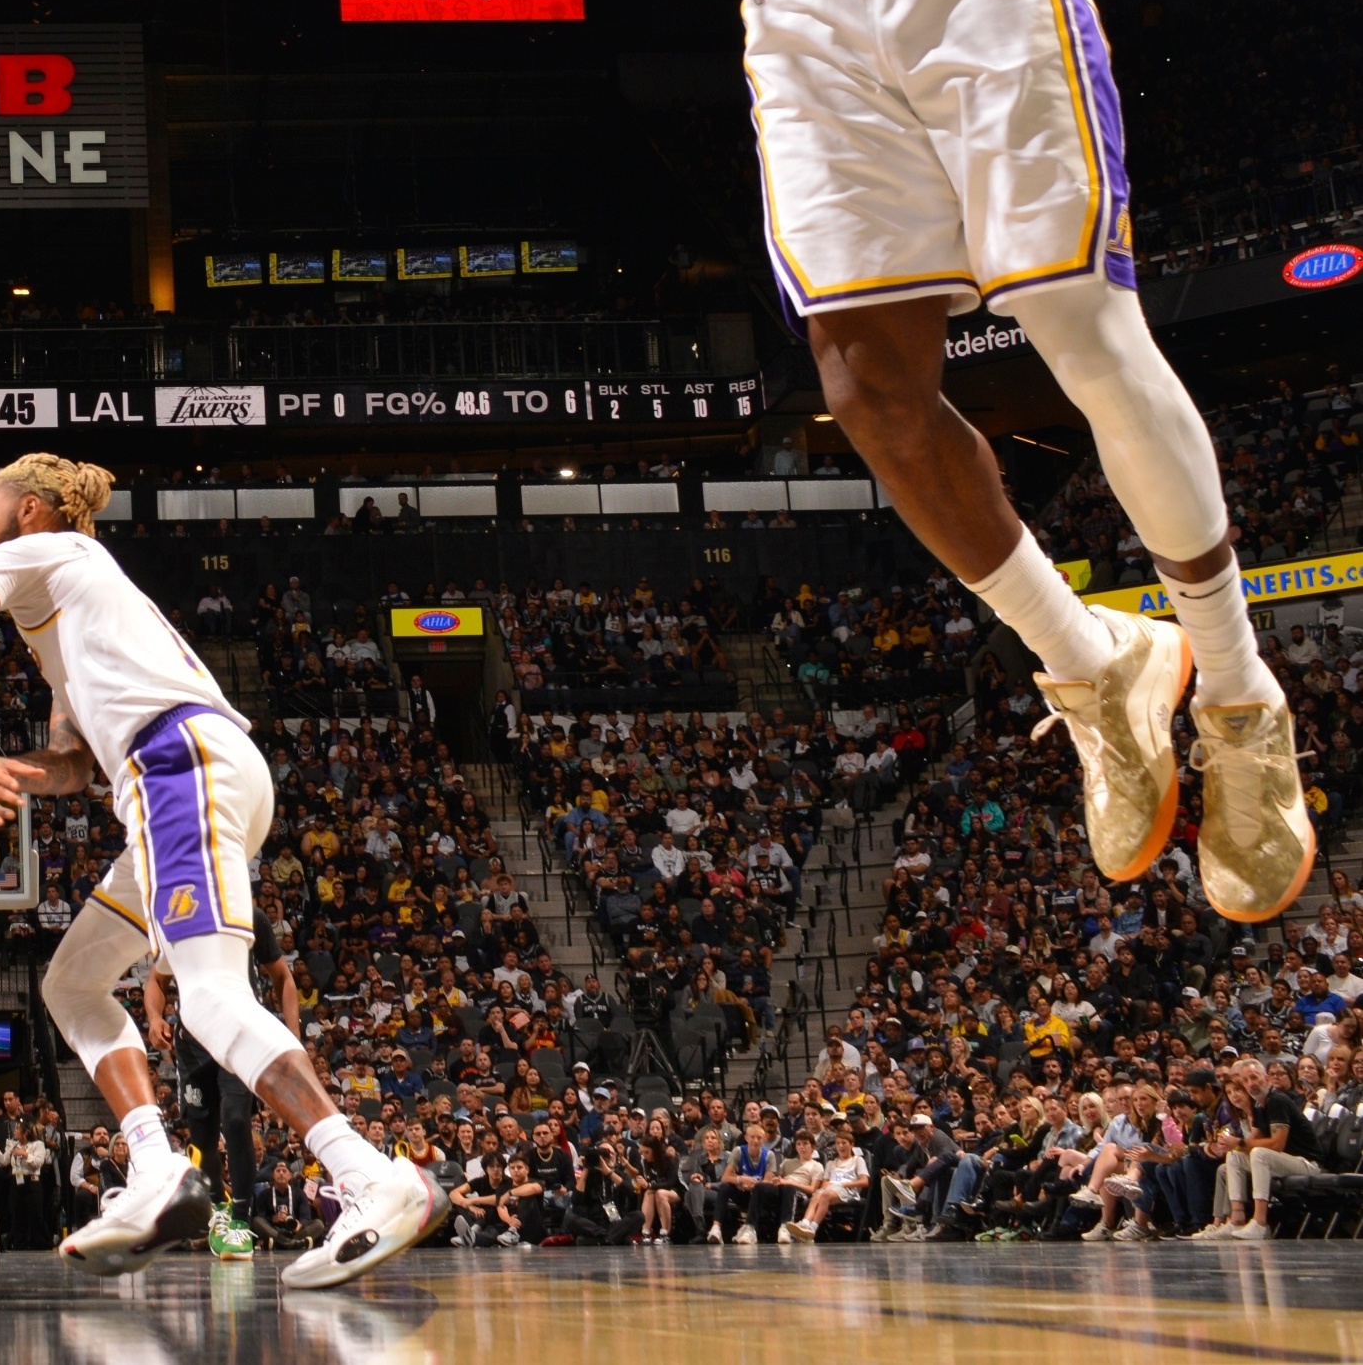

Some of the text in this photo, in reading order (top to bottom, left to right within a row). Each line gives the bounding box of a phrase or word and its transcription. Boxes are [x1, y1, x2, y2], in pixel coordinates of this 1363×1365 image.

[1298, 253, 1348, 279] AHIA
[599, 379, 756, 395] BLK STL AST REB
[70, 392, 144, 422] LAL
[167, 395, 253, 424] LAKERS
[278, 389, 577, 417] PF 0 FG% 48.6 TO 6
[611, 396, 752, 419] 2 5 10 15
[201, 555, 230, 571] 115
[703, 548, 731, 563] 116
[422, 617, 451, 627] AHIA
